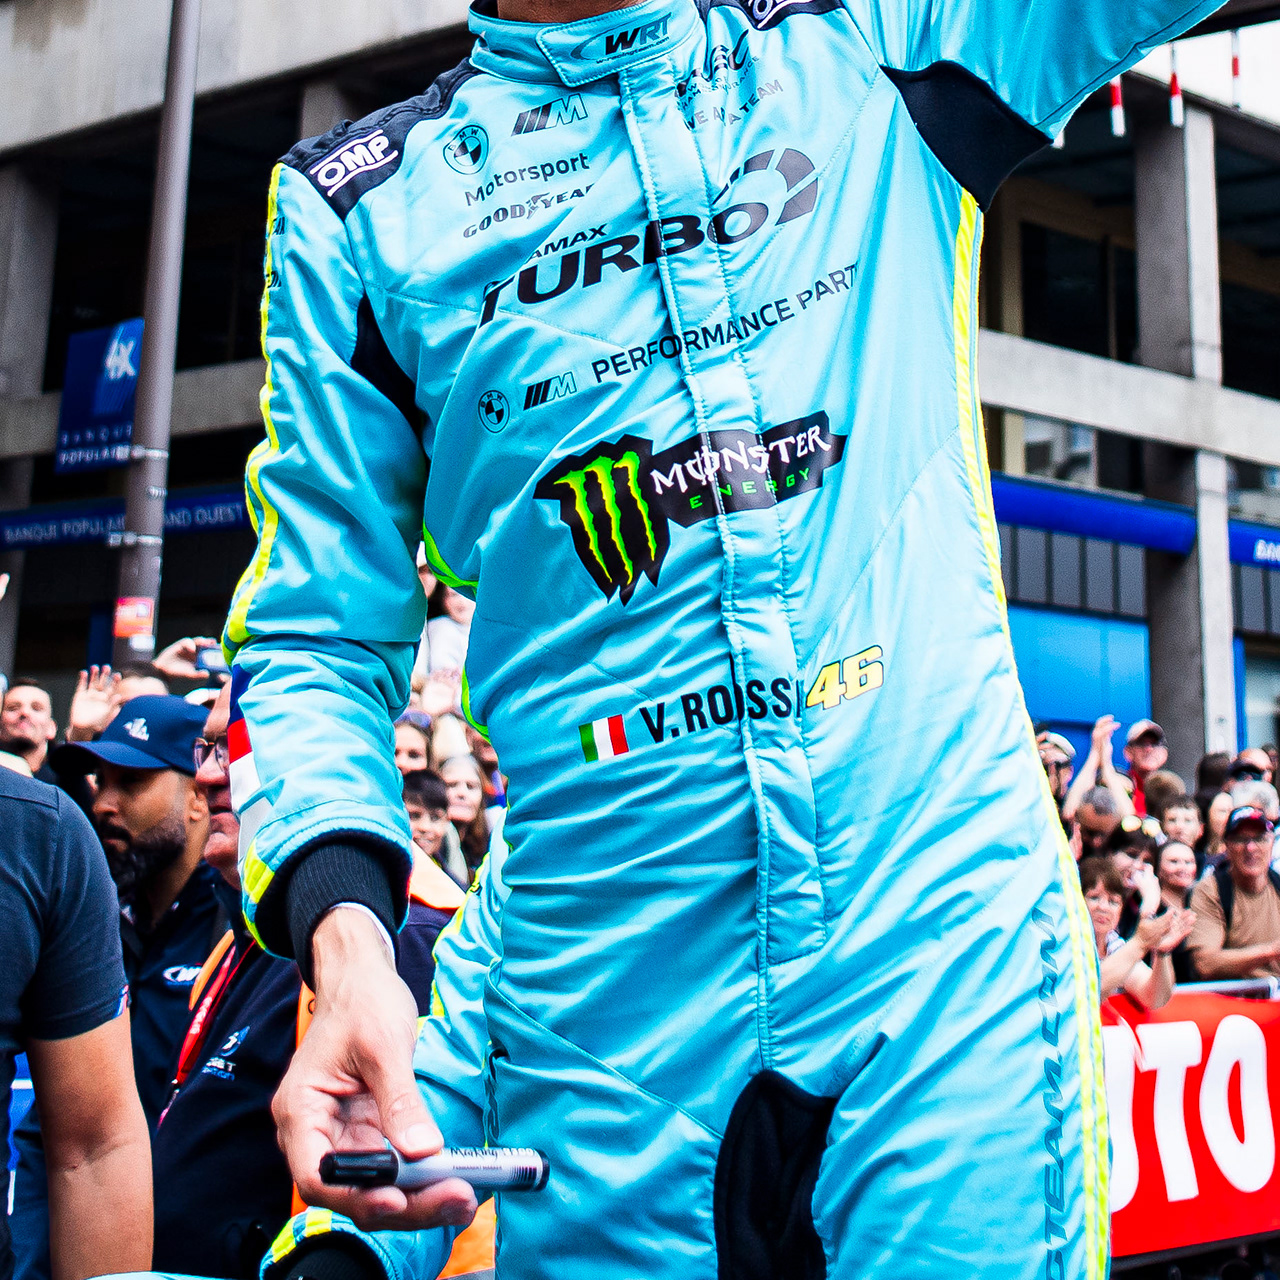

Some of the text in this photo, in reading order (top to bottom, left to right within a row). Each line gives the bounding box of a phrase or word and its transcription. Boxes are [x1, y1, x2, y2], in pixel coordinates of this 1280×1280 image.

[605, 12, 671, 56] WRT
[739, 79, 784, 114] TEAM
[317, 133, 391, 188] OMP
[464, 152, 590, 207] Motorsport
[478, 201, 770, 329] TURBO
[527, 223, 609, 261] AMAX
[591, 298, 796, 384] PERFORMANCE
[795, 261, 859, 311] PART
[650, 423, 832, 495] MONSTER
[689, 467, 811, 510] ENERGY
[638, 644, 885, 745] V.ROSSI 46
